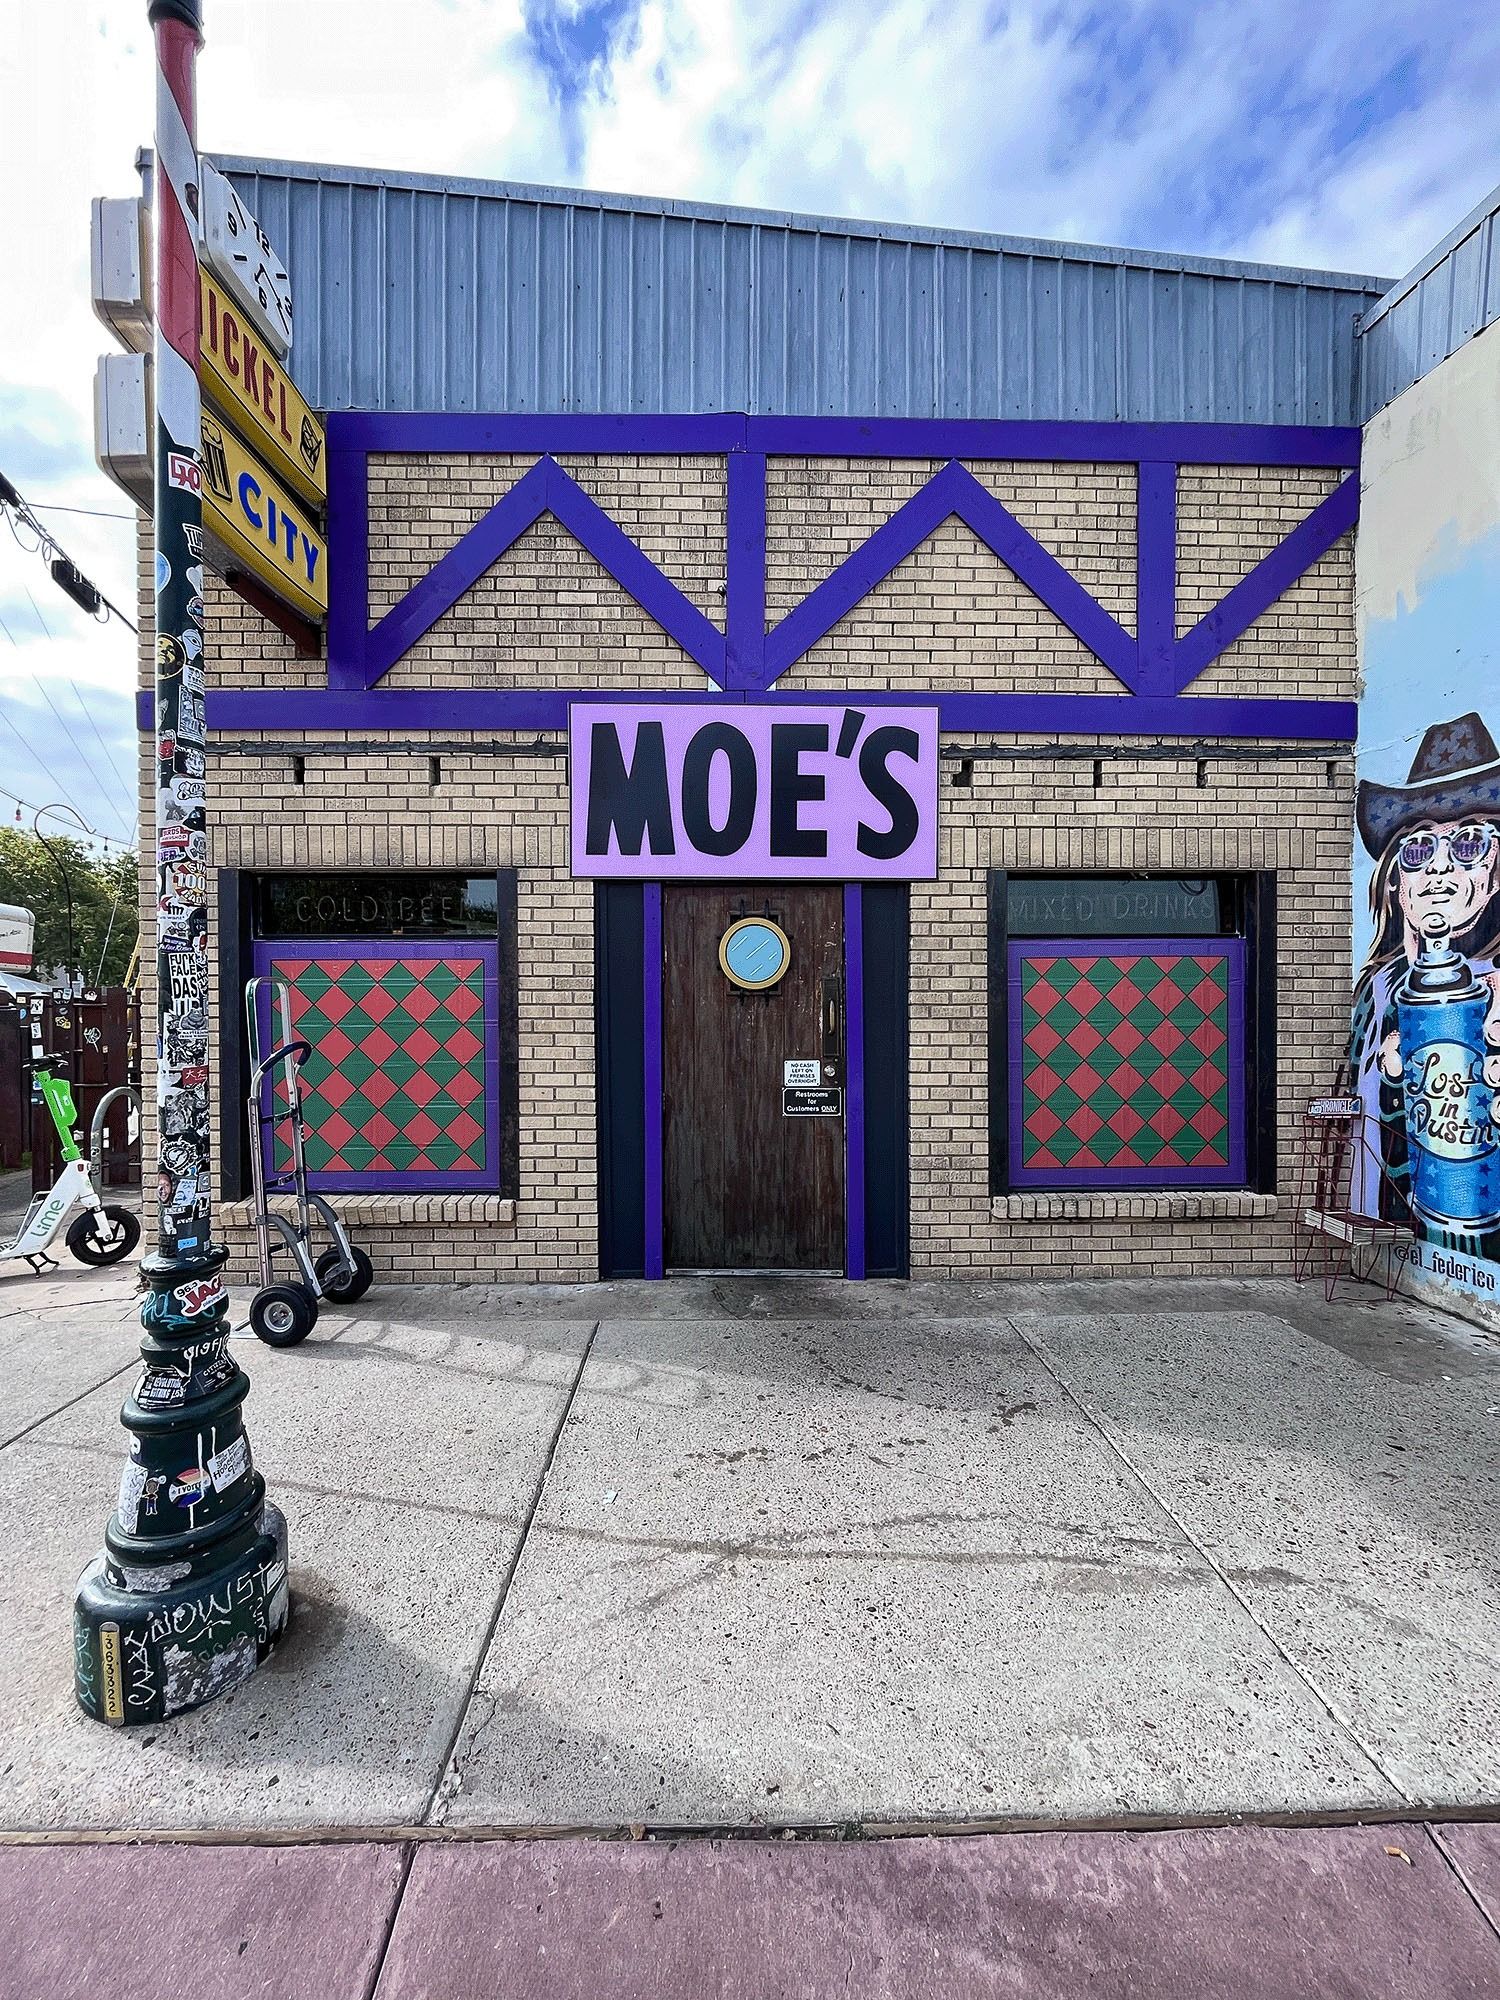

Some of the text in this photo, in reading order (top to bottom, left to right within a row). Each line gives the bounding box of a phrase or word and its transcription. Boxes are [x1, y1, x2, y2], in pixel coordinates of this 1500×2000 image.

[227, 211, 237, 237] 9
[253, 220, 270, 258] 12
[200, 280, 293, 447] ICKEL
[239, 472, 319, 583] CITY
[586, 708, 919, 860] MOE'S
[296, 896, 379, 922] COLD
[1009, 894, 1214, 921] MIXED DRINKS
[170, 953, 195, 970] FUCK
[171, 964, 196, 976] FACE
[172, 977, 198, 998] DAS
[1407, 1053, 1483, 1099] Lost
[1410, 1099, 1494, 1144] Dustin
[1439, 1098, 1460, 1119] in
[104, 1638, 117, 1713] 363322
